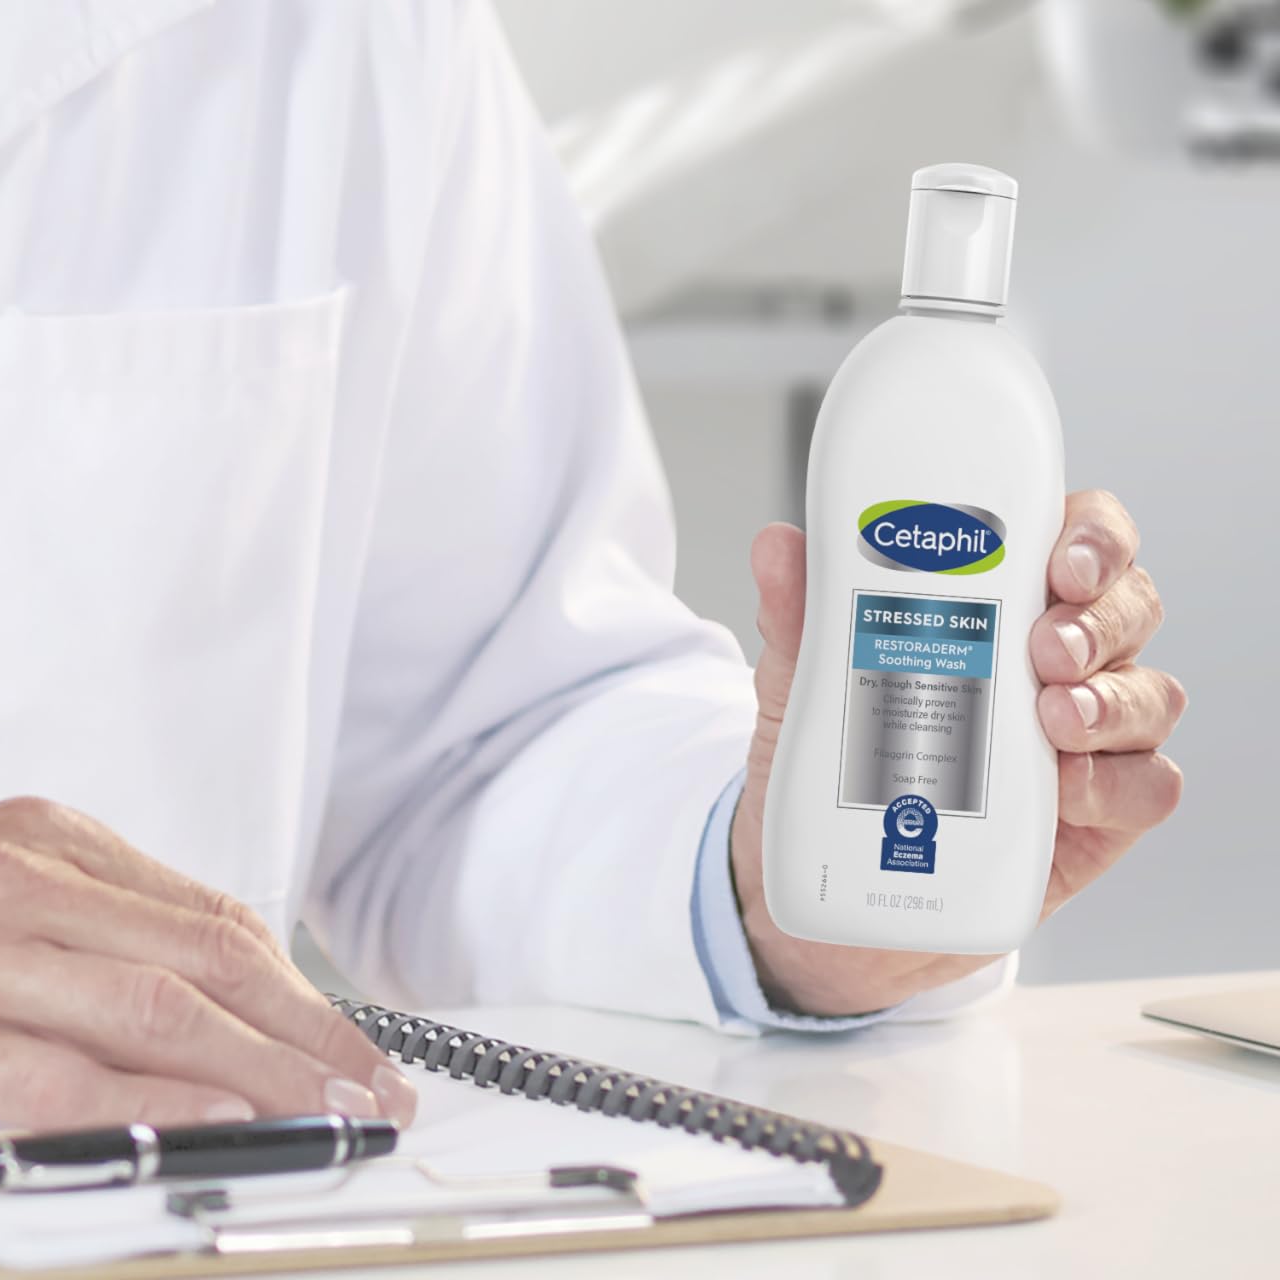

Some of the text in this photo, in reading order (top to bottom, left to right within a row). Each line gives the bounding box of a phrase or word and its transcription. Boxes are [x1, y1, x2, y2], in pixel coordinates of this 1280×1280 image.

[863, 609, 987, 631] STRESSED SKIN
[878, 654, 966, 671] Soothing Wash
[881, 678, 912, 691] Rough
[914, 680, 958, 693] Sensitive
[961, 684, 982, 695] Skin
[883, 694, 956, 709] Clinically proven
[872, 706, 966, 722] to moisturize dry skin
[883, 719, 952, 735] while cleansing
[916, 751, 958, 764] Complex
[892, 773, 938, 785] Soap Free
[892, 798, 931, 814] ACCEPTED
[893, 843, 924, 852] National
[893, 851, 924, 860] Eczema
[887, 857, 929, 868] Association
[866, 892, 876, 907] 10
[878, 893, 888, 907] FL
[889, 894, 902, 908] OZ
